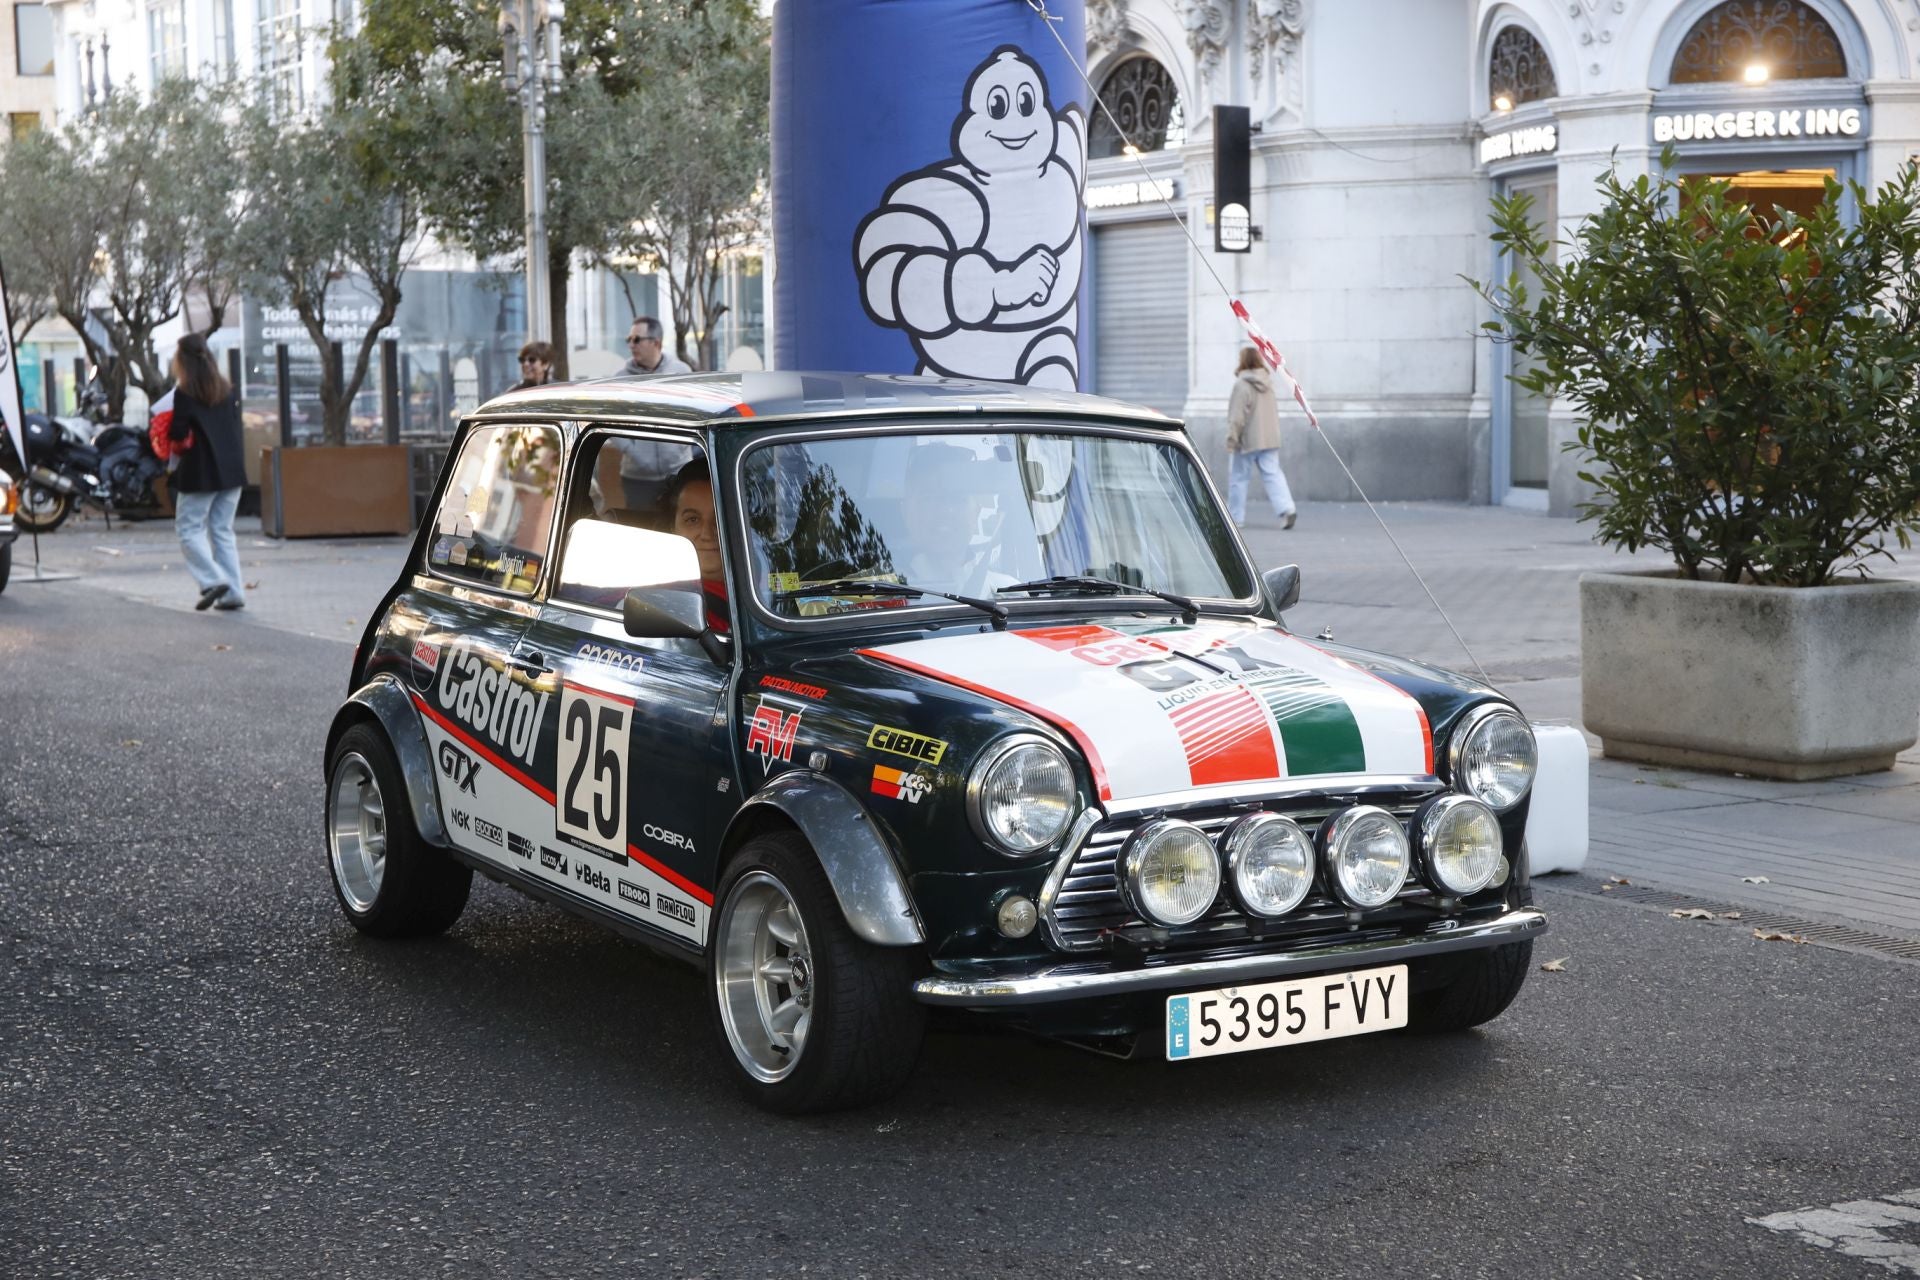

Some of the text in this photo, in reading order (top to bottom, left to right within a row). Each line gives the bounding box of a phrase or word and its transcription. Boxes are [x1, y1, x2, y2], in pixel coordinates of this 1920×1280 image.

[1654, 108, 1861, 142] BURGER KING
[414, 641, 438, 667] Castrol
[439, 634, 550, 767] Castrol
[439, 740, 482, 799] GTX
[564, 698, 624, 840] 25
[451, 808, 470, 831] NGK
[475, 818, 503, 842] sparco
[643, 824, 696, 853] COBRA
[584, 864, 611, 893] Beta
[620, 884, 648, 904] FERODO
[1199, 974, 1396, 1046] 5395 FVY
[1175, 1033, 1184, 1048] E
